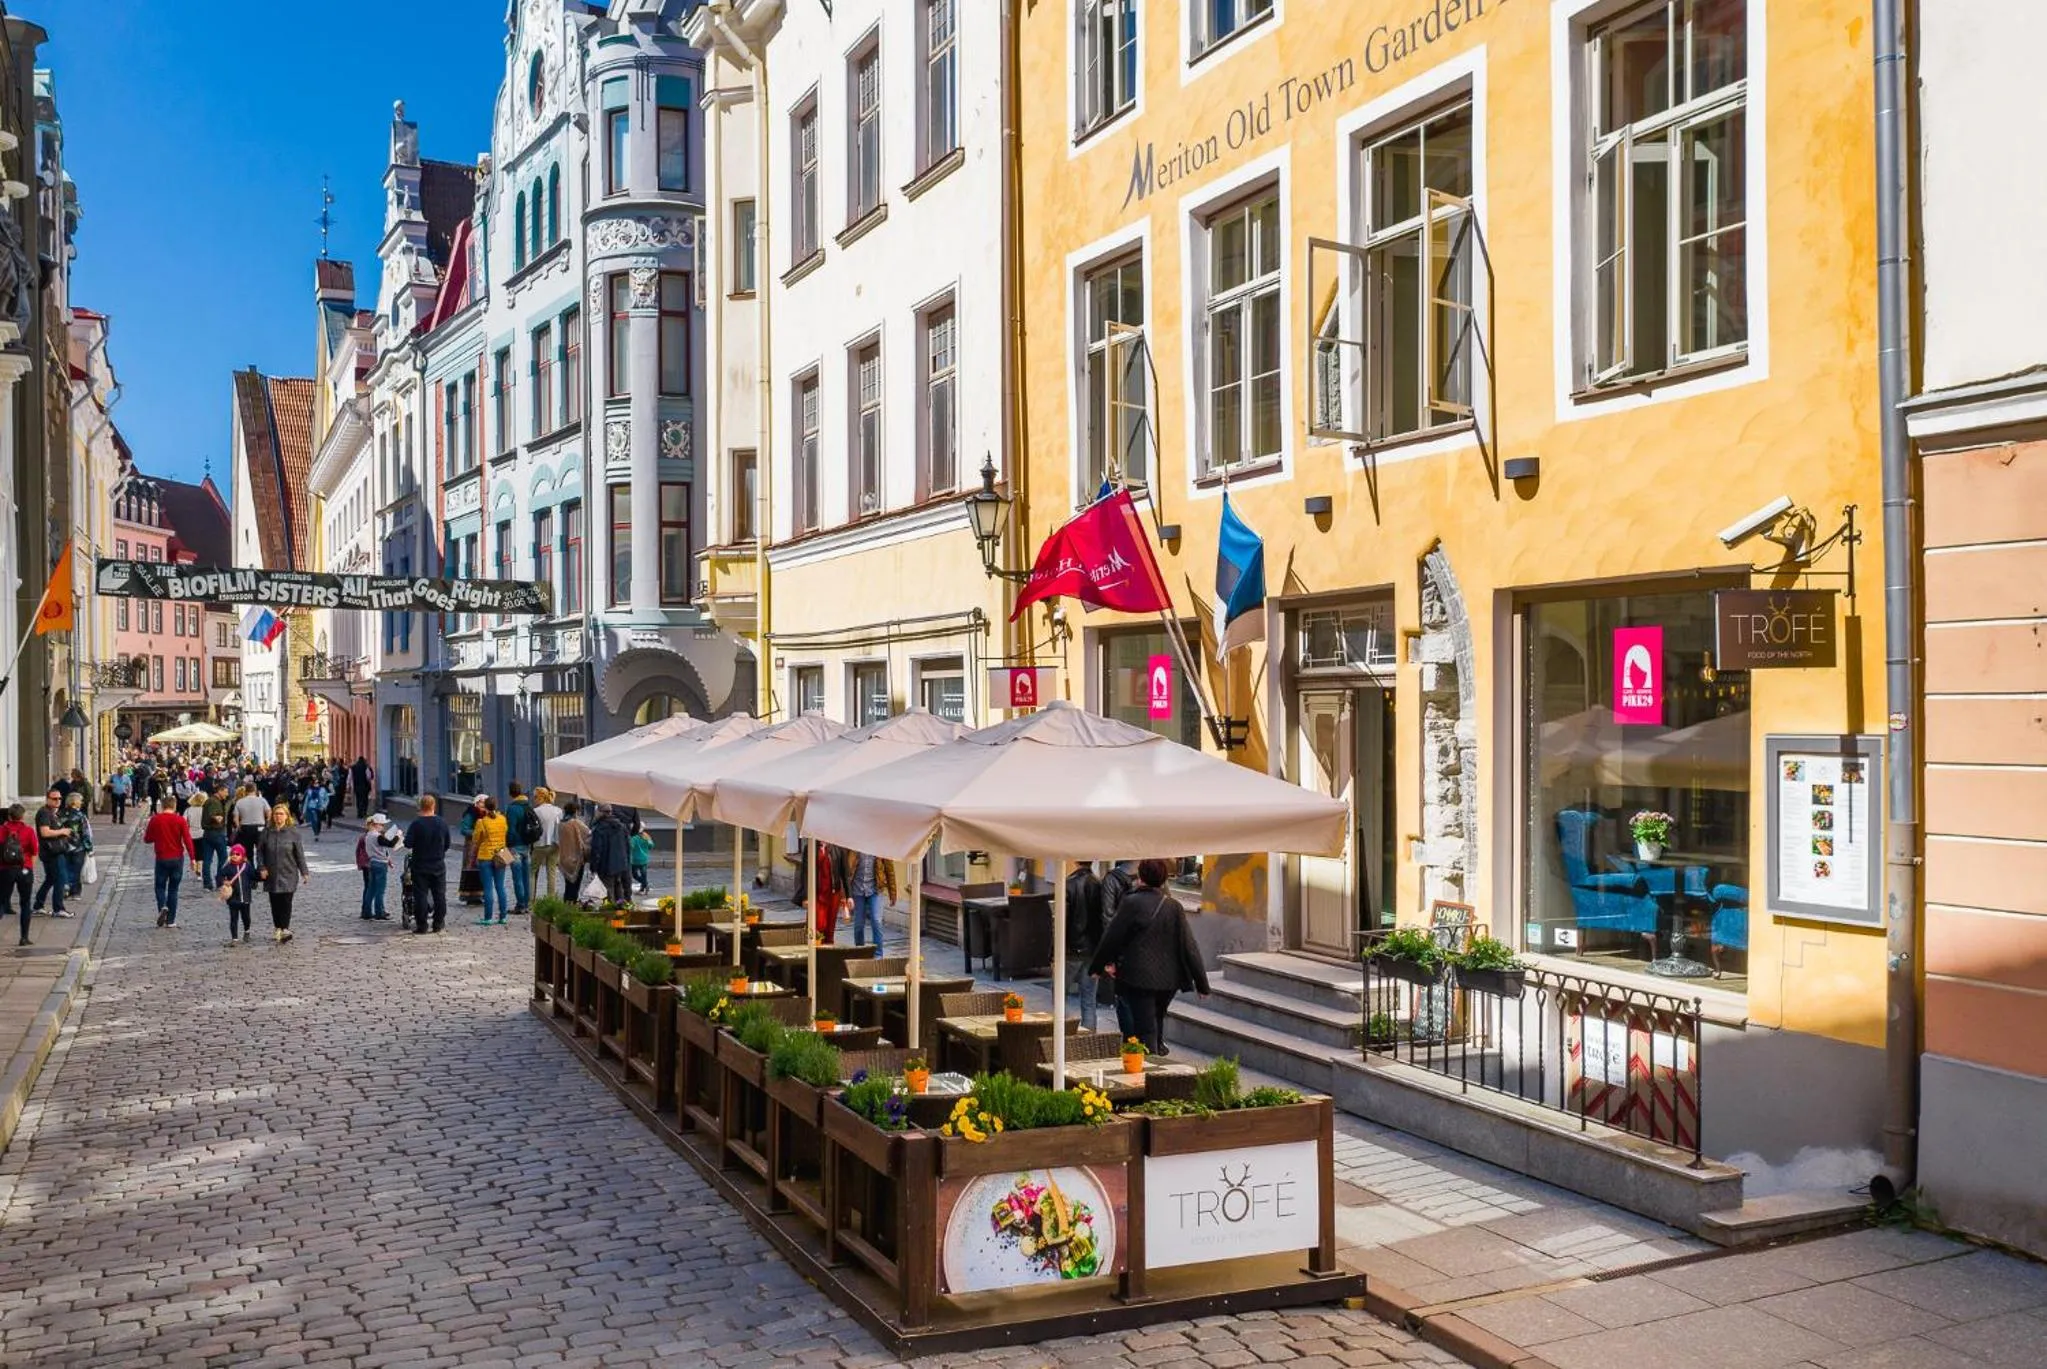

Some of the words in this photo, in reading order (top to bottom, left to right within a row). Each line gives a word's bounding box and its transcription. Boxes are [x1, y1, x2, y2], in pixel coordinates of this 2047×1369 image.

[1121, 134, 1218, 212] Meriton
[1225, 92, 1271, 151] Old
[1278, 56, 1354, 122] Town
[1364, 0, 1484, 75] Garden
[155, 565, 177, 577] THE
[167, 570, 256, 599] BIOFILM
[257, 580, 339, 607] SISTERS
[341, 576, 368, 597] All
[368, 587, 413, 609] That
[413, 578, 457, 611] Goes
[451, 580, 501, 608] Right
